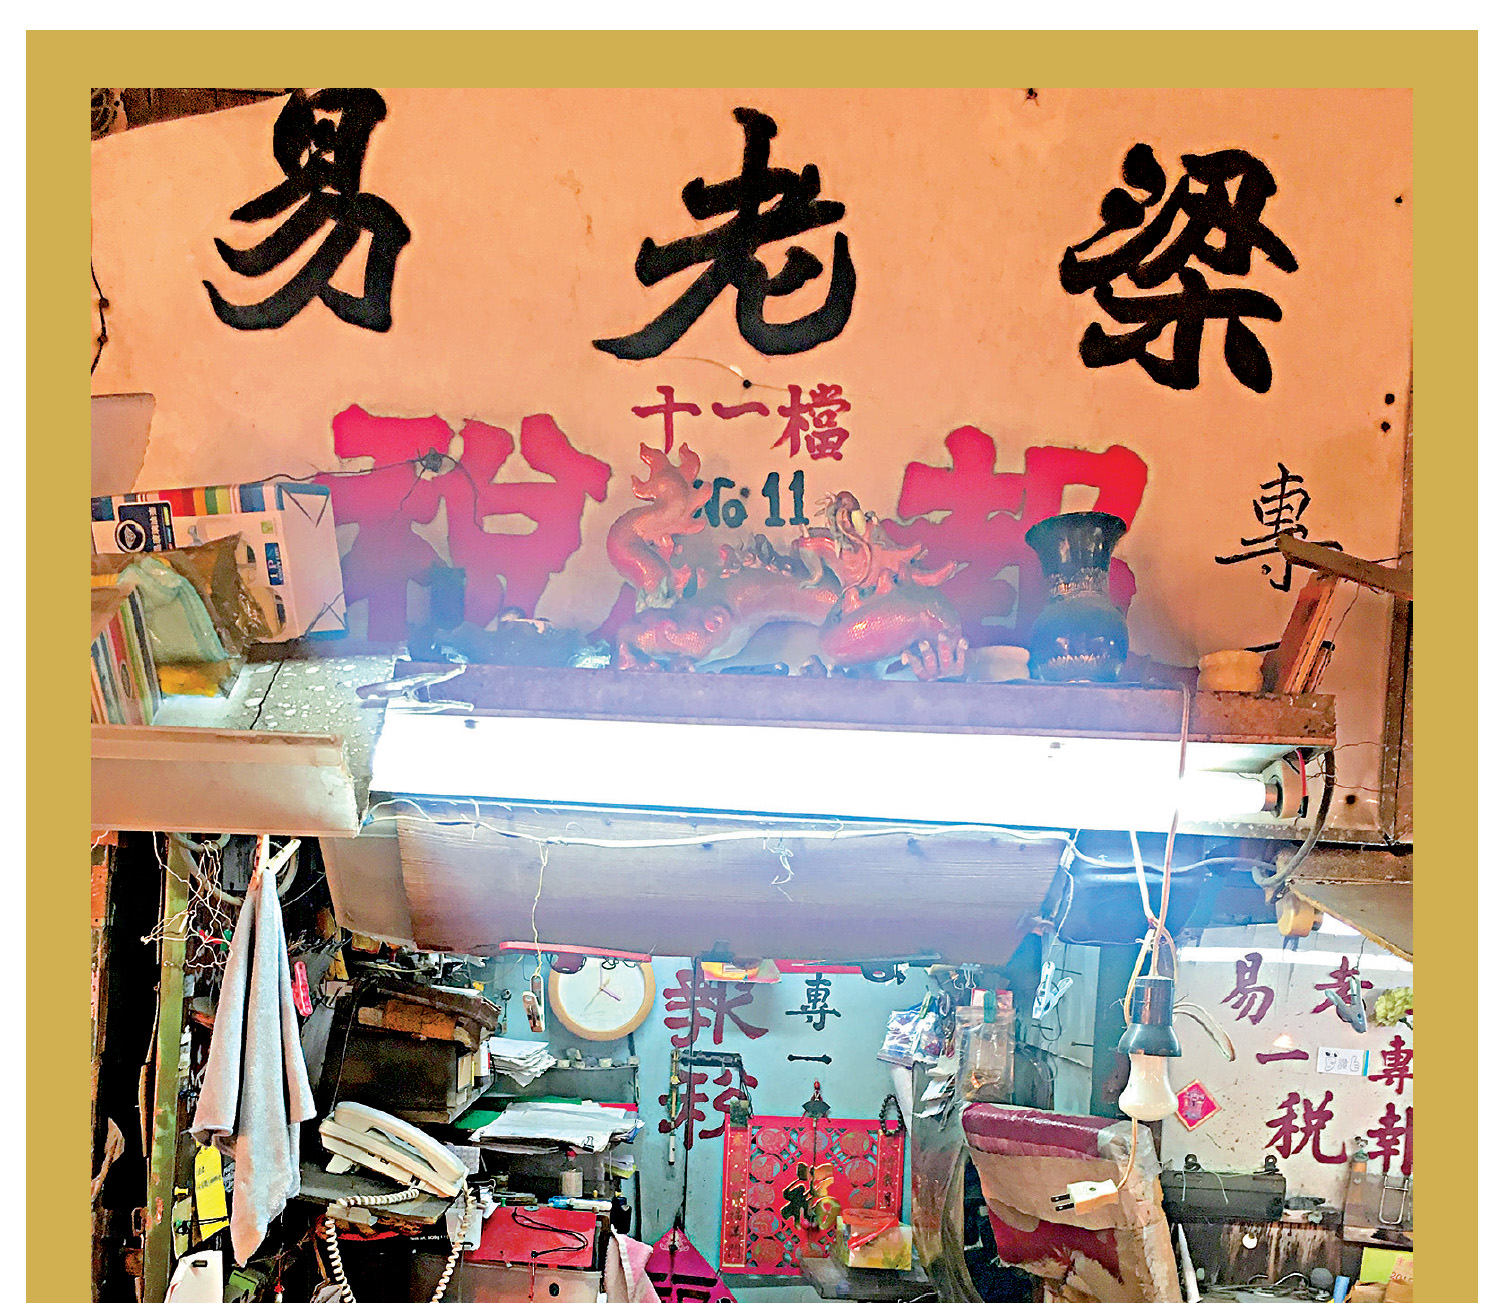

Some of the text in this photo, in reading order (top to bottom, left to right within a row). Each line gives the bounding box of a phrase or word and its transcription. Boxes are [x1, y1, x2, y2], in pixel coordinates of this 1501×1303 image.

[631, 383, 851, 461] 十一檔
[762, 469, 810, 527] 11
